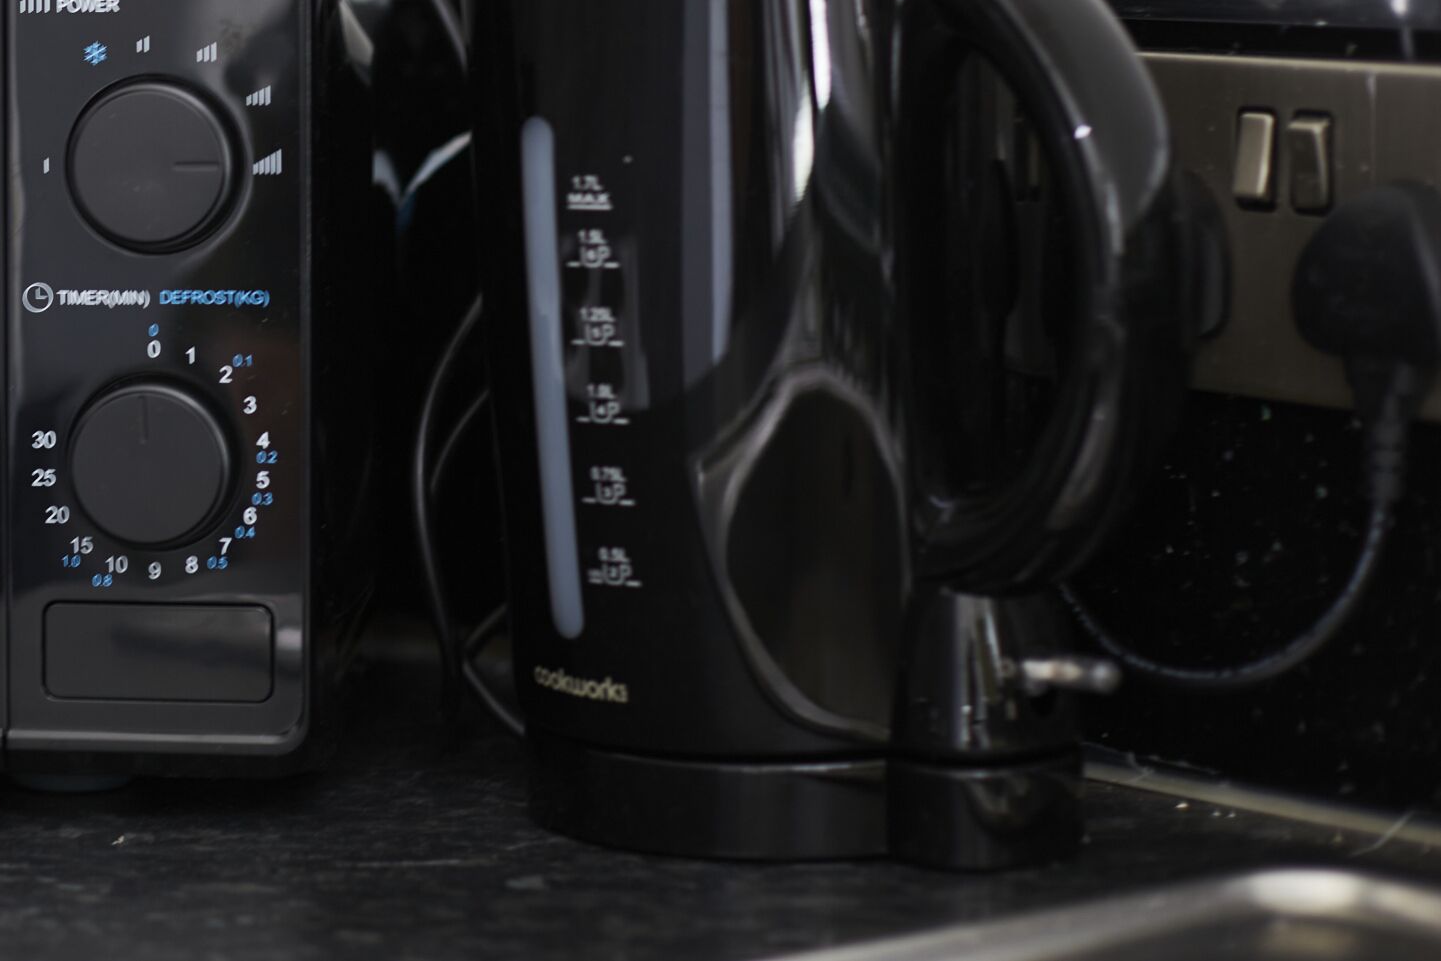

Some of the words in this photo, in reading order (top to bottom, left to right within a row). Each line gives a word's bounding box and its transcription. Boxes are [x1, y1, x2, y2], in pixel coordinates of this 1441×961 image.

[567, 193, 610, 204] MAX
[56, 290, 150, 308] TIMER(MIN)
[160, 290, 269, 306] DEFROST(KG)
[147, 340, 162, 358] 0
[185, 347, 196, 364] 1
[219, 366, 233, 383] 2
[243, 396, 257, 414] 3
[31, 431, 57, 448] 30
[255, 432, 271, 448] 4
[31, 469, 57, 486] 25
[256, 471, 270, 488] 5
[44, 506, 70, 523] 20
[243, 507, 258, 524] 6
[70, 537, 94, 554] 15
[219, 538, 233, 555] 7
[105, 556, 129, 573] 10
[148, 562, 162, 579] 9
[185, 556, 199, 573] 8
[534, 666, 629, 703] cookworks
